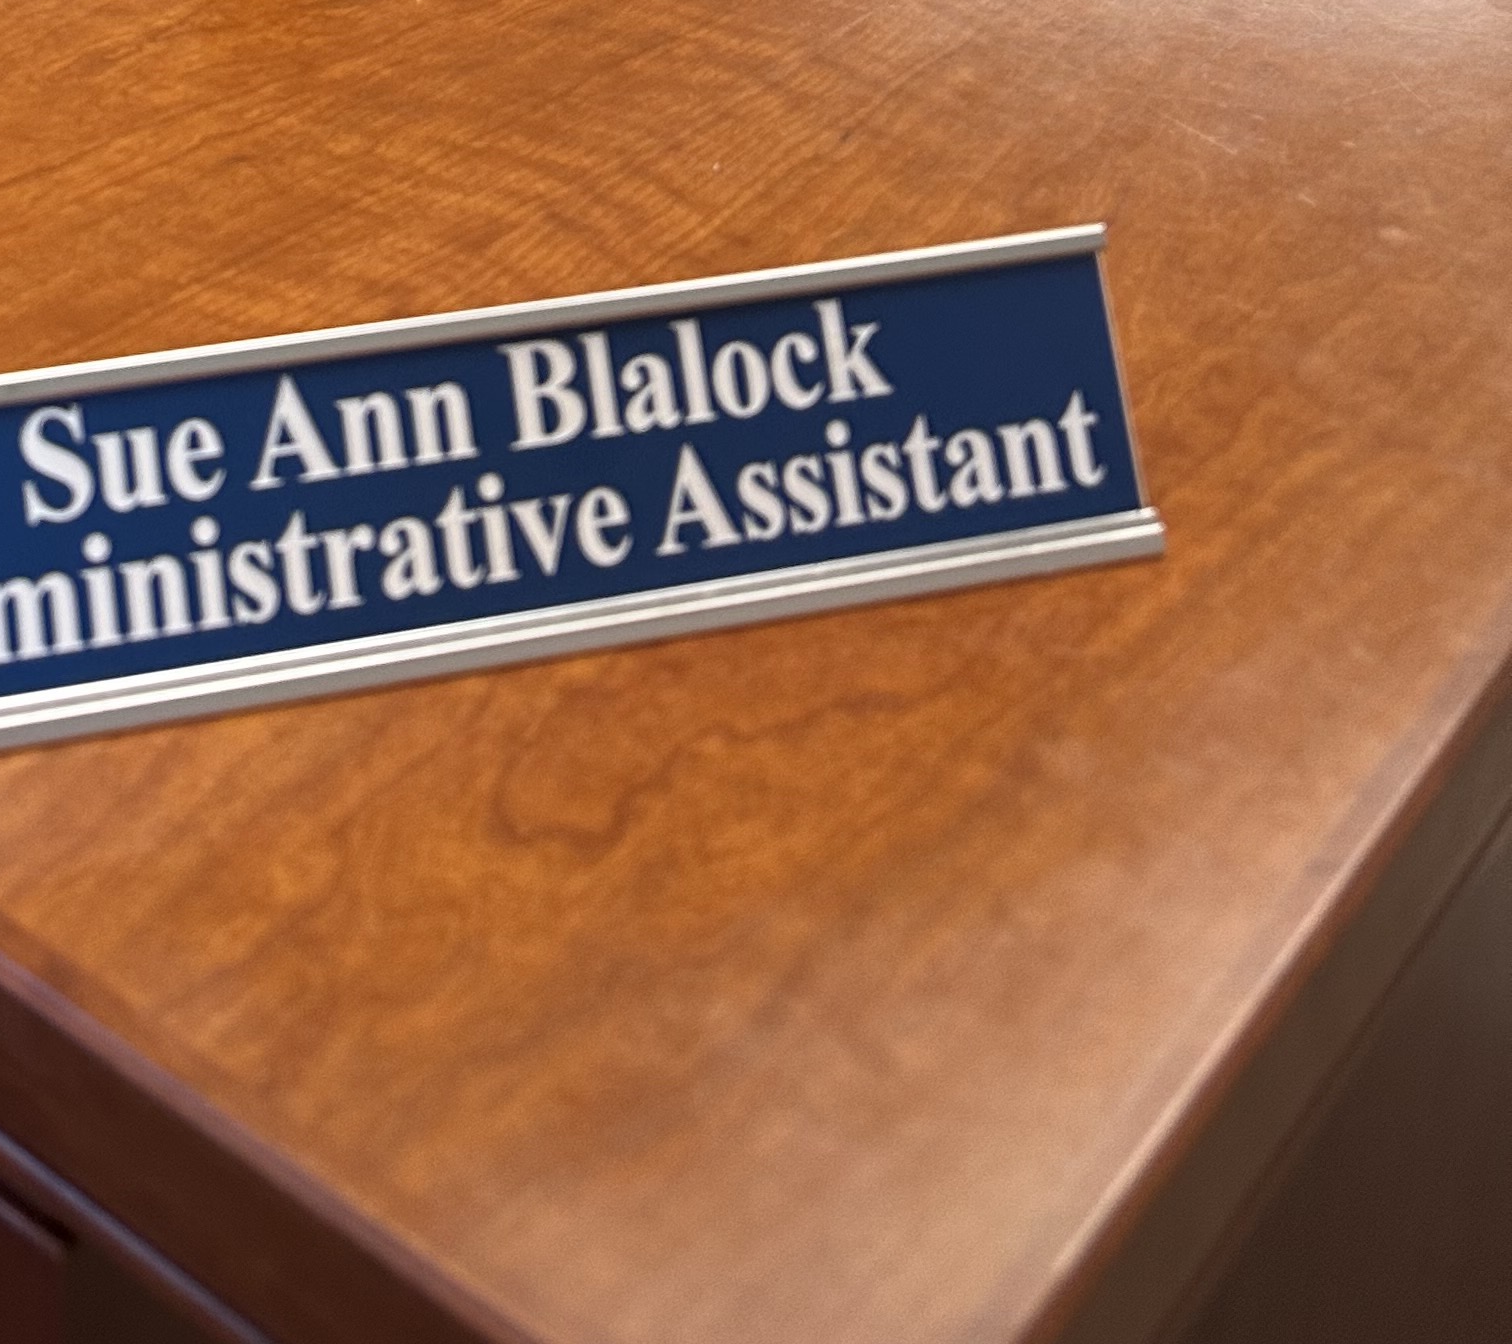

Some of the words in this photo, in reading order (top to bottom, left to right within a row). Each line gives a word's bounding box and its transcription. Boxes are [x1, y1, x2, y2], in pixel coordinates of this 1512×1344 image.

[18, 403, 224, 527] Sue
[248, 373, 478, 490] Ann
[498, 300, 892, 454] Blalock
[653, 390, 1106, 555] Assistant
